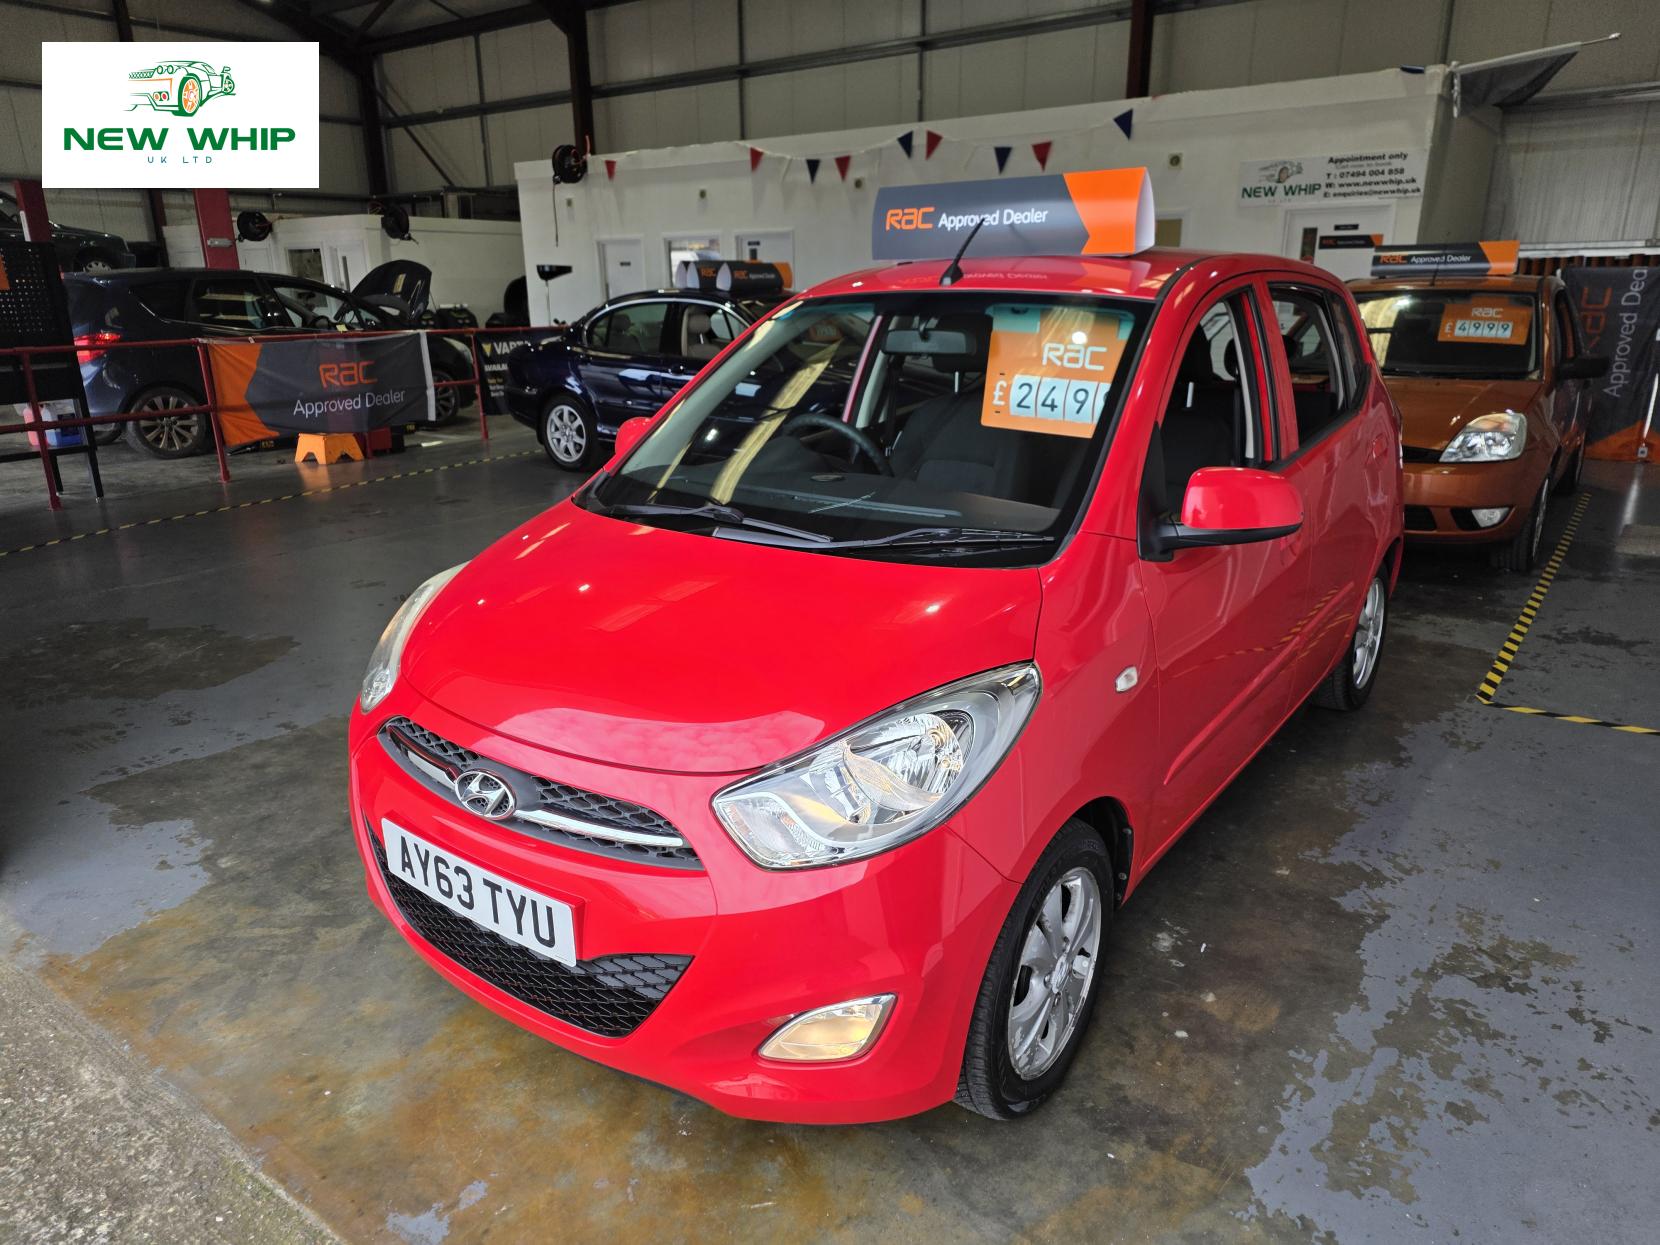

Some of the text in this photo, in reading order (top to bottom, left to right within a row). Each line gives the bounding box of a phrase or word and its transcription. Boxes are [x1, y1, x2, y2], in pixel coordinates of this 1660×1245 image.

[1328, 152, 1408, 164] Appointment only
[1241, 183, 1322, 199] NEW WHIP
[938, 210, 1000, 231] Approved
[1002, 208, 1049, 225] Dealer
[1410, 254, 1445, 264] Approved
[1446, 254, 1472, 263] Dealer
[1602, 313, 1638, 398] Approved
[293, 389, 406, 419] Approved Dealer
[992, 380, 1110, 415] £249
[400, 835, 556, 949] AY63 TYU
